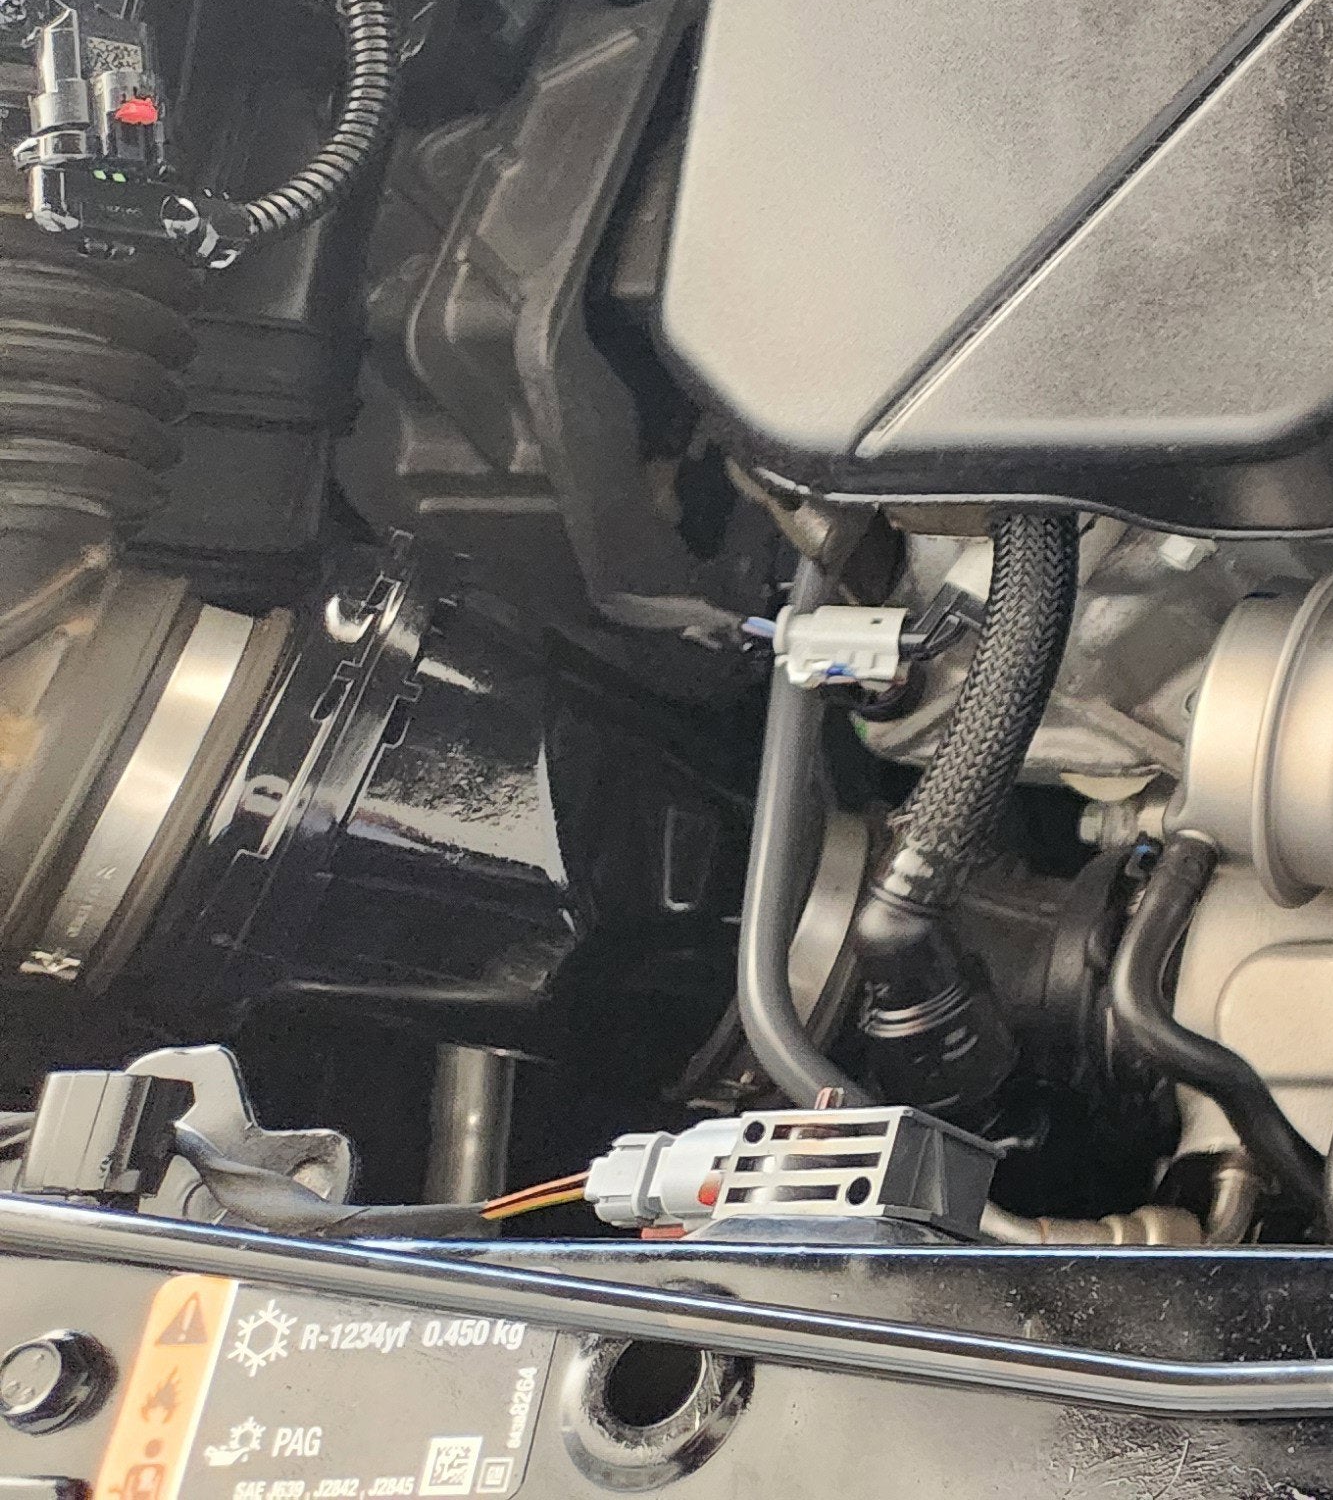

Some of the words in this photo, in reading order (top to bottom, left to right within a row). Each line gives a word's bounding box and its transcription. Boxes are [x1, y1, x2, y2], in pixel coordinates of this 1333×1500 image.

[300, 1321, 412, 1353] R-1234yf
[421, 1319, 491, 1348] 0.450
[492, 1318, 528, 1350] kg
[272, 1426, 323, 1457] PAG
[233, 1481, 267, 1500] SAE
